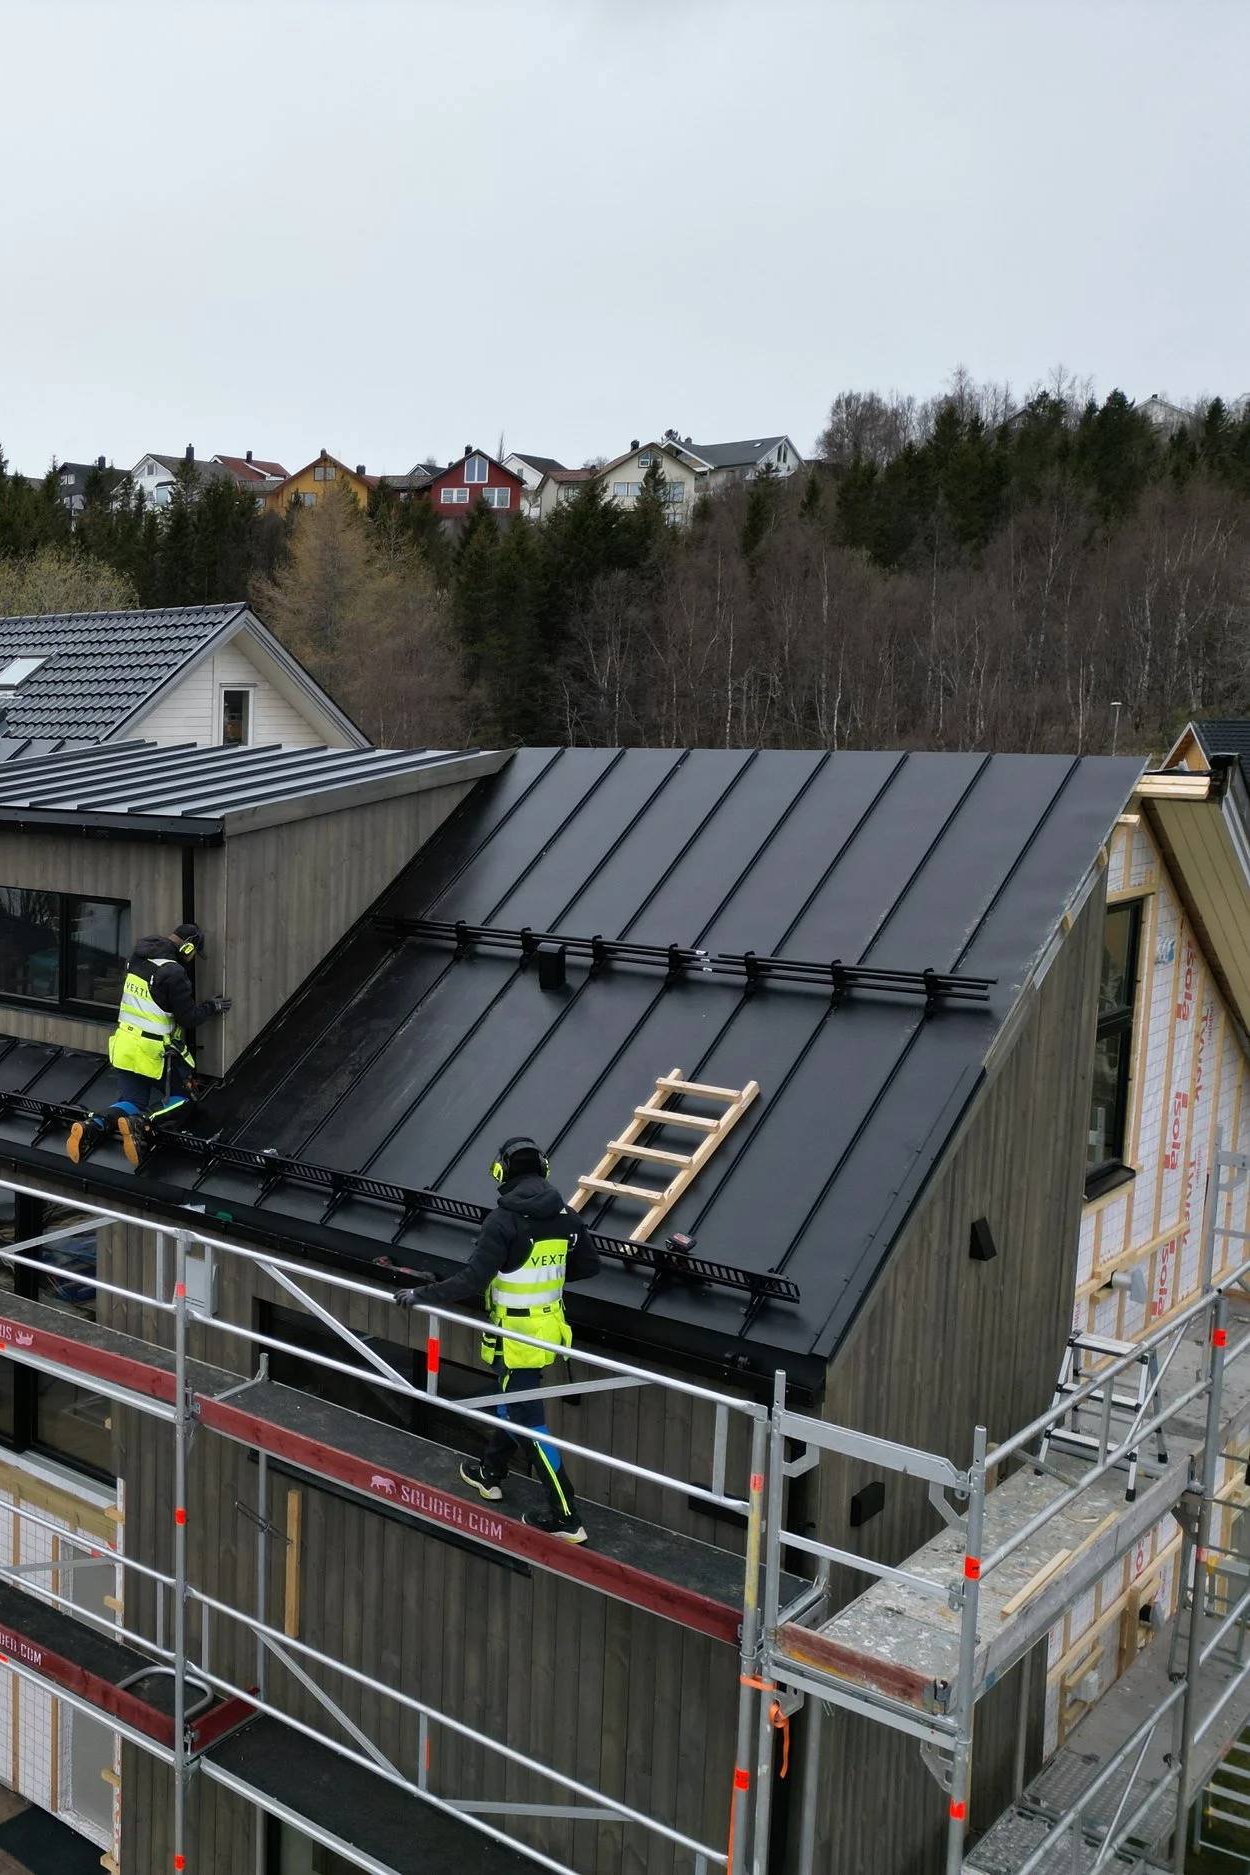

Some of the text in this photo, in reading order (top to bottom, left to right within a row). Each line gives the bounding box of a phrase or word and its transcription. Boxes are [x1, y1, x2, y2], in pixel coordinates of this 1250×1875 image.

[1164, 1092, 1189, 1170] isola
[531, 1253, 567, 1267] VEXT
[401, 1484, 503, 1541] SOLIDEQ.COM
